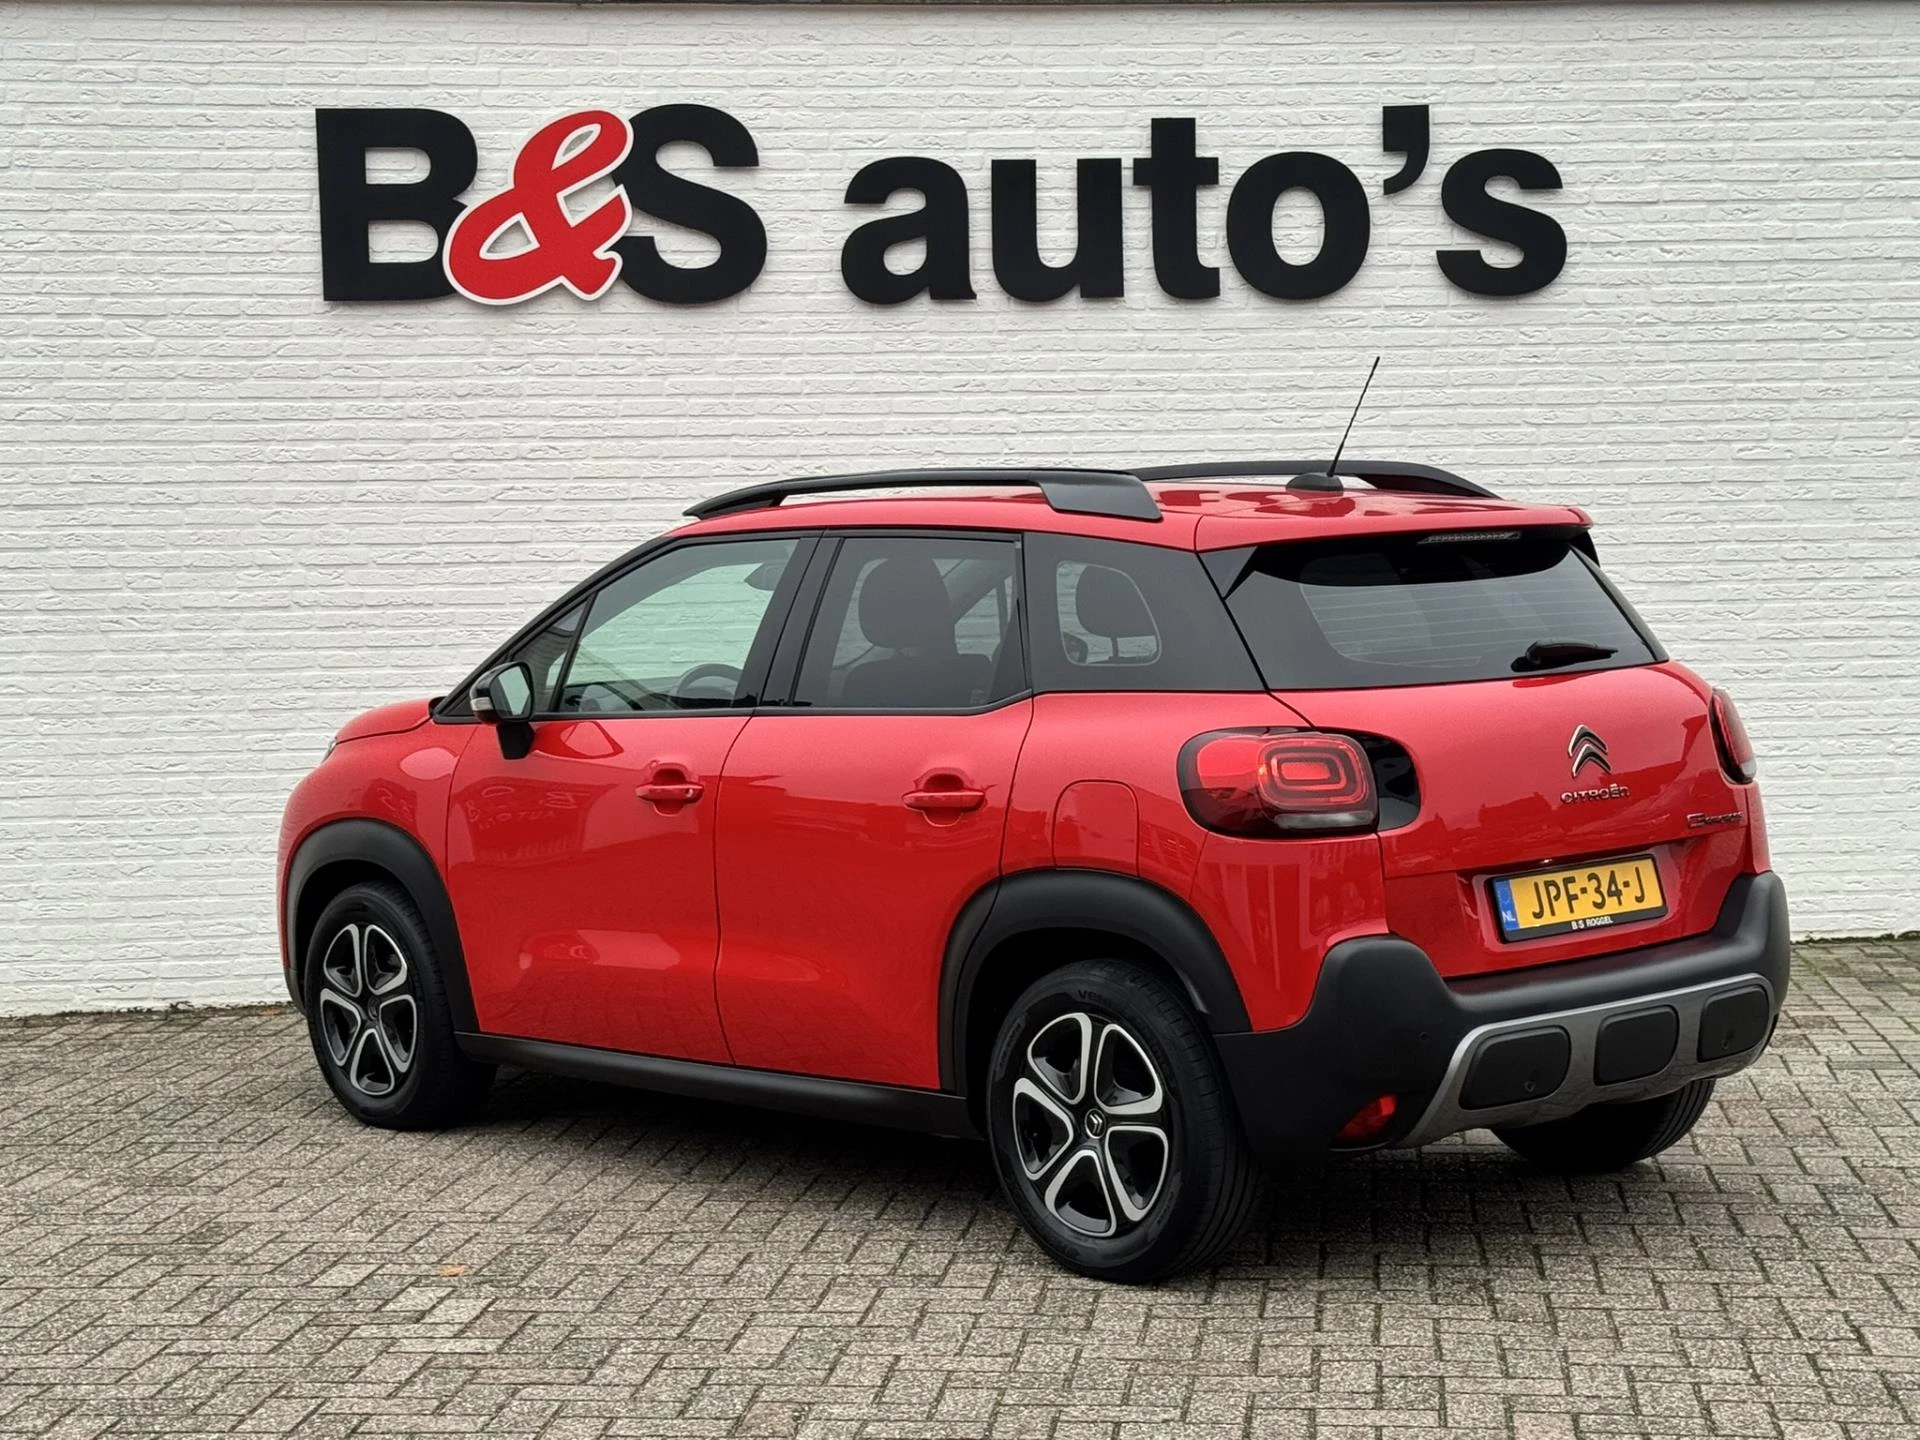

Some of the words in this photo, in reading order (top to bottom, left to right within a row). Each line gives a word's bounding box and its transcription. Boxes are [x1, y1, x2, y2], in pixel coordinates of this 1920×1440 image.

[316, 104, 767, 306] B&S
[841, 105, 1567, 305] auto's
[1502, 910, 1516, 923] NL
[1532, 866, 1645, 919] JPF-34-J
